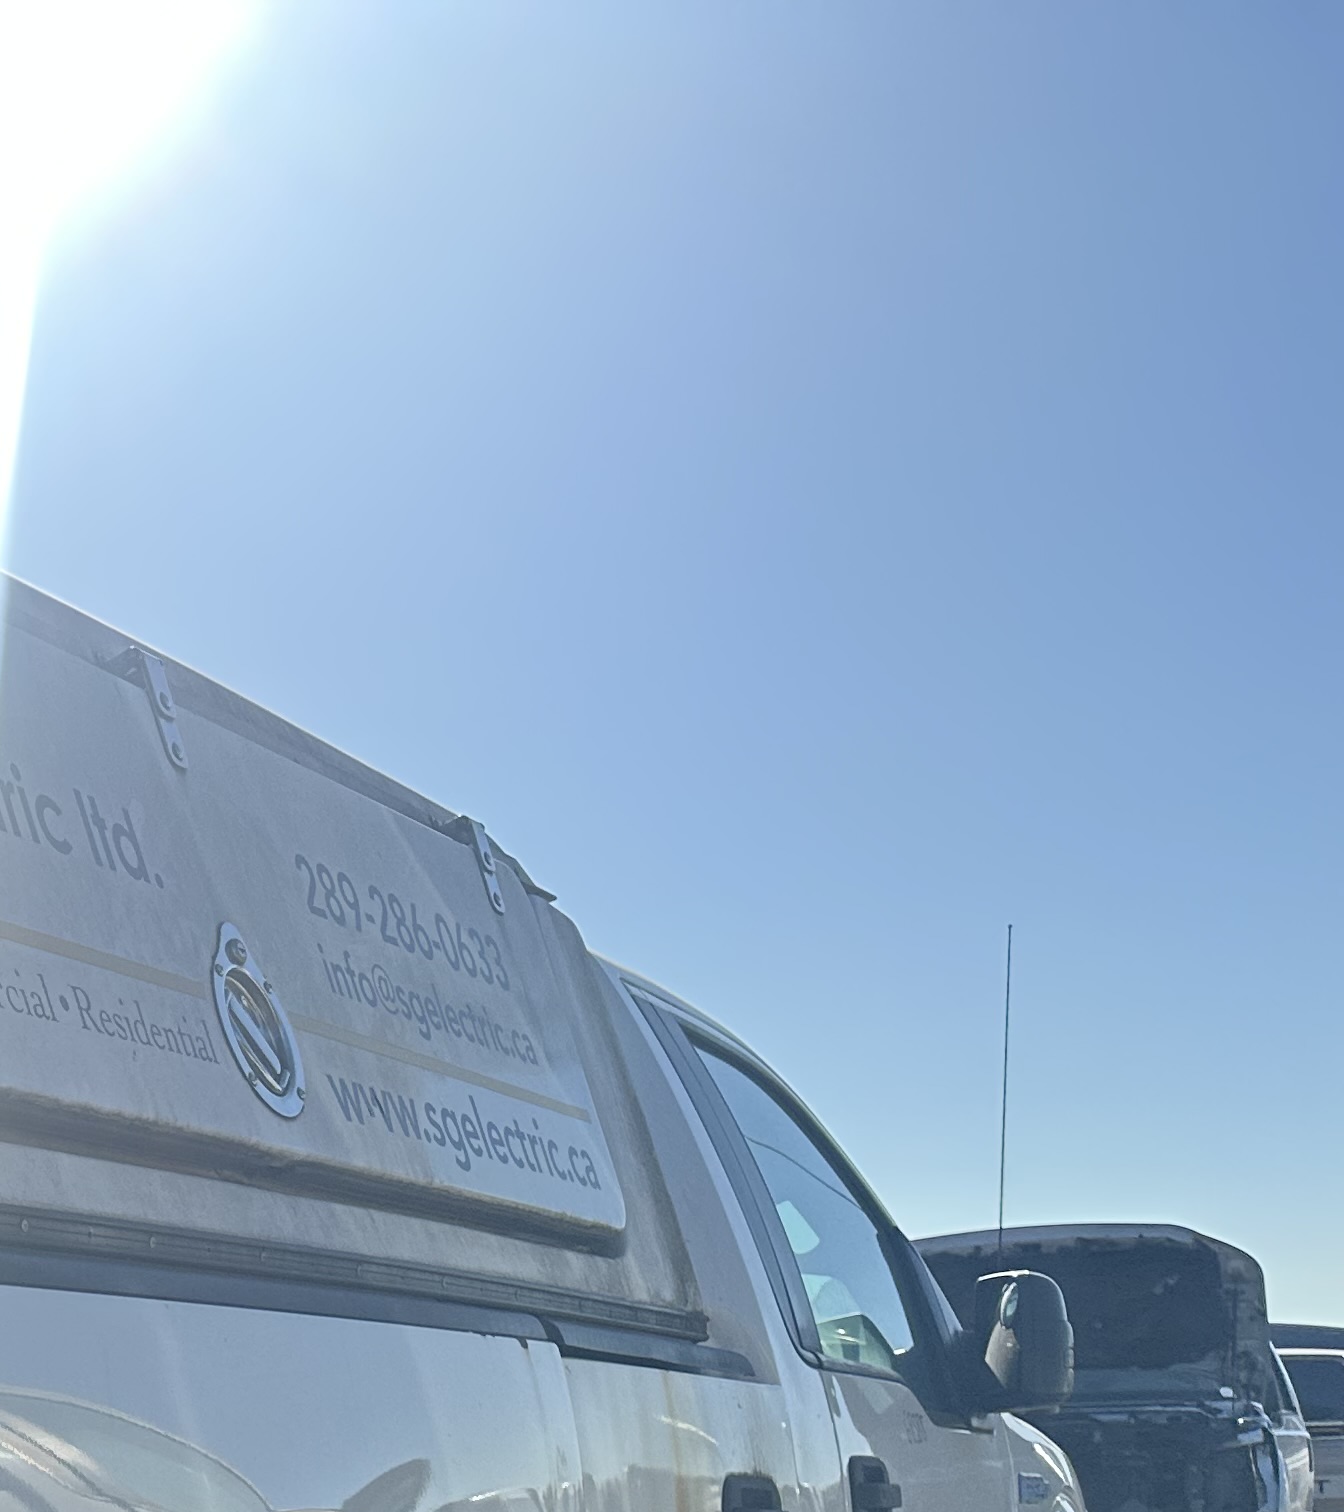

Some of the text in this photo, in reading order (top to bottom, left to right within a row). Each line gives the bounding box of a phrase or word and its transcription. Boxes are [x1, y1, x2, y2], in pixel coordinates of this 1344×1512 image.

[73, 788, 164, 889] ltd.
[295, 853, 510, 991] 289-286-0633
[69, 984, 221, 1065] Residential
[317, 943, 539, 1066] info@sgelectric.ca
[326, 1073, 602, 1191] www.sgelectric.ca
